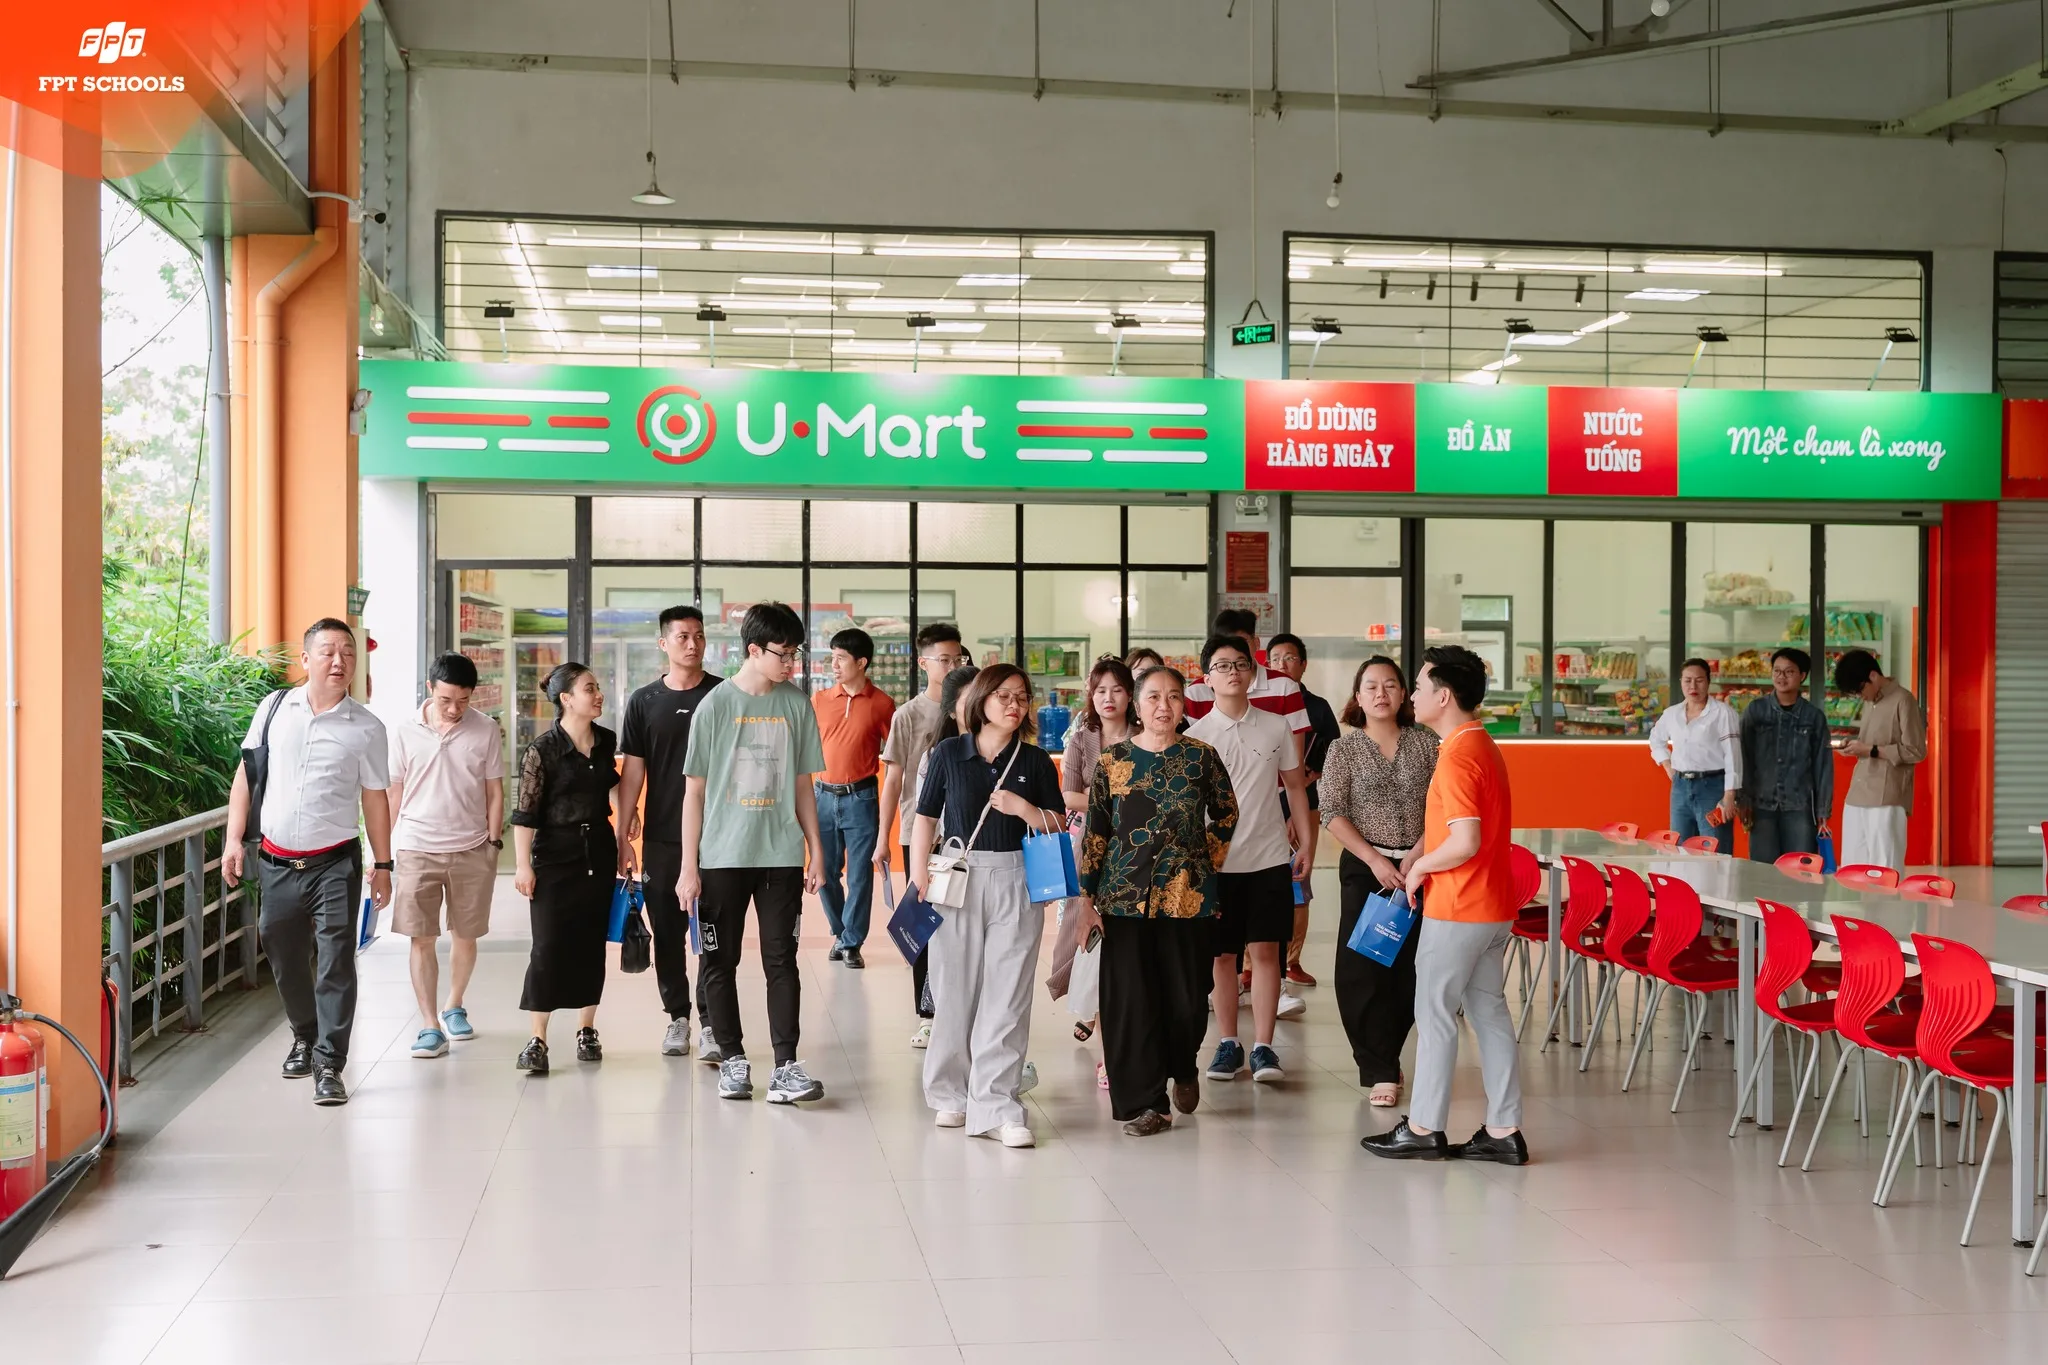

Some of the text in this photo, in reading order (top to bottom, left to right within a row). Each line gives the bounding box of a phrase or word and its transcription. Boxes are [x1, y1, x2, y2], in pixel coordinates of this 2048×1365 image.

[1284, 398, 1377, 432] ĐỒ DÙNG
[1583, 407, 1643, 437] NƯỚC
[1447, 419, 1512, 452] ĐỒ ĂN
[1726, 424, 1946, 472] Một chạm là xong
[1266, 438, 1394, 468] HÀNG NGÀY
[1584, 440, 1642, 472] UỐNG
[740, 798, 775, 806] COURT
